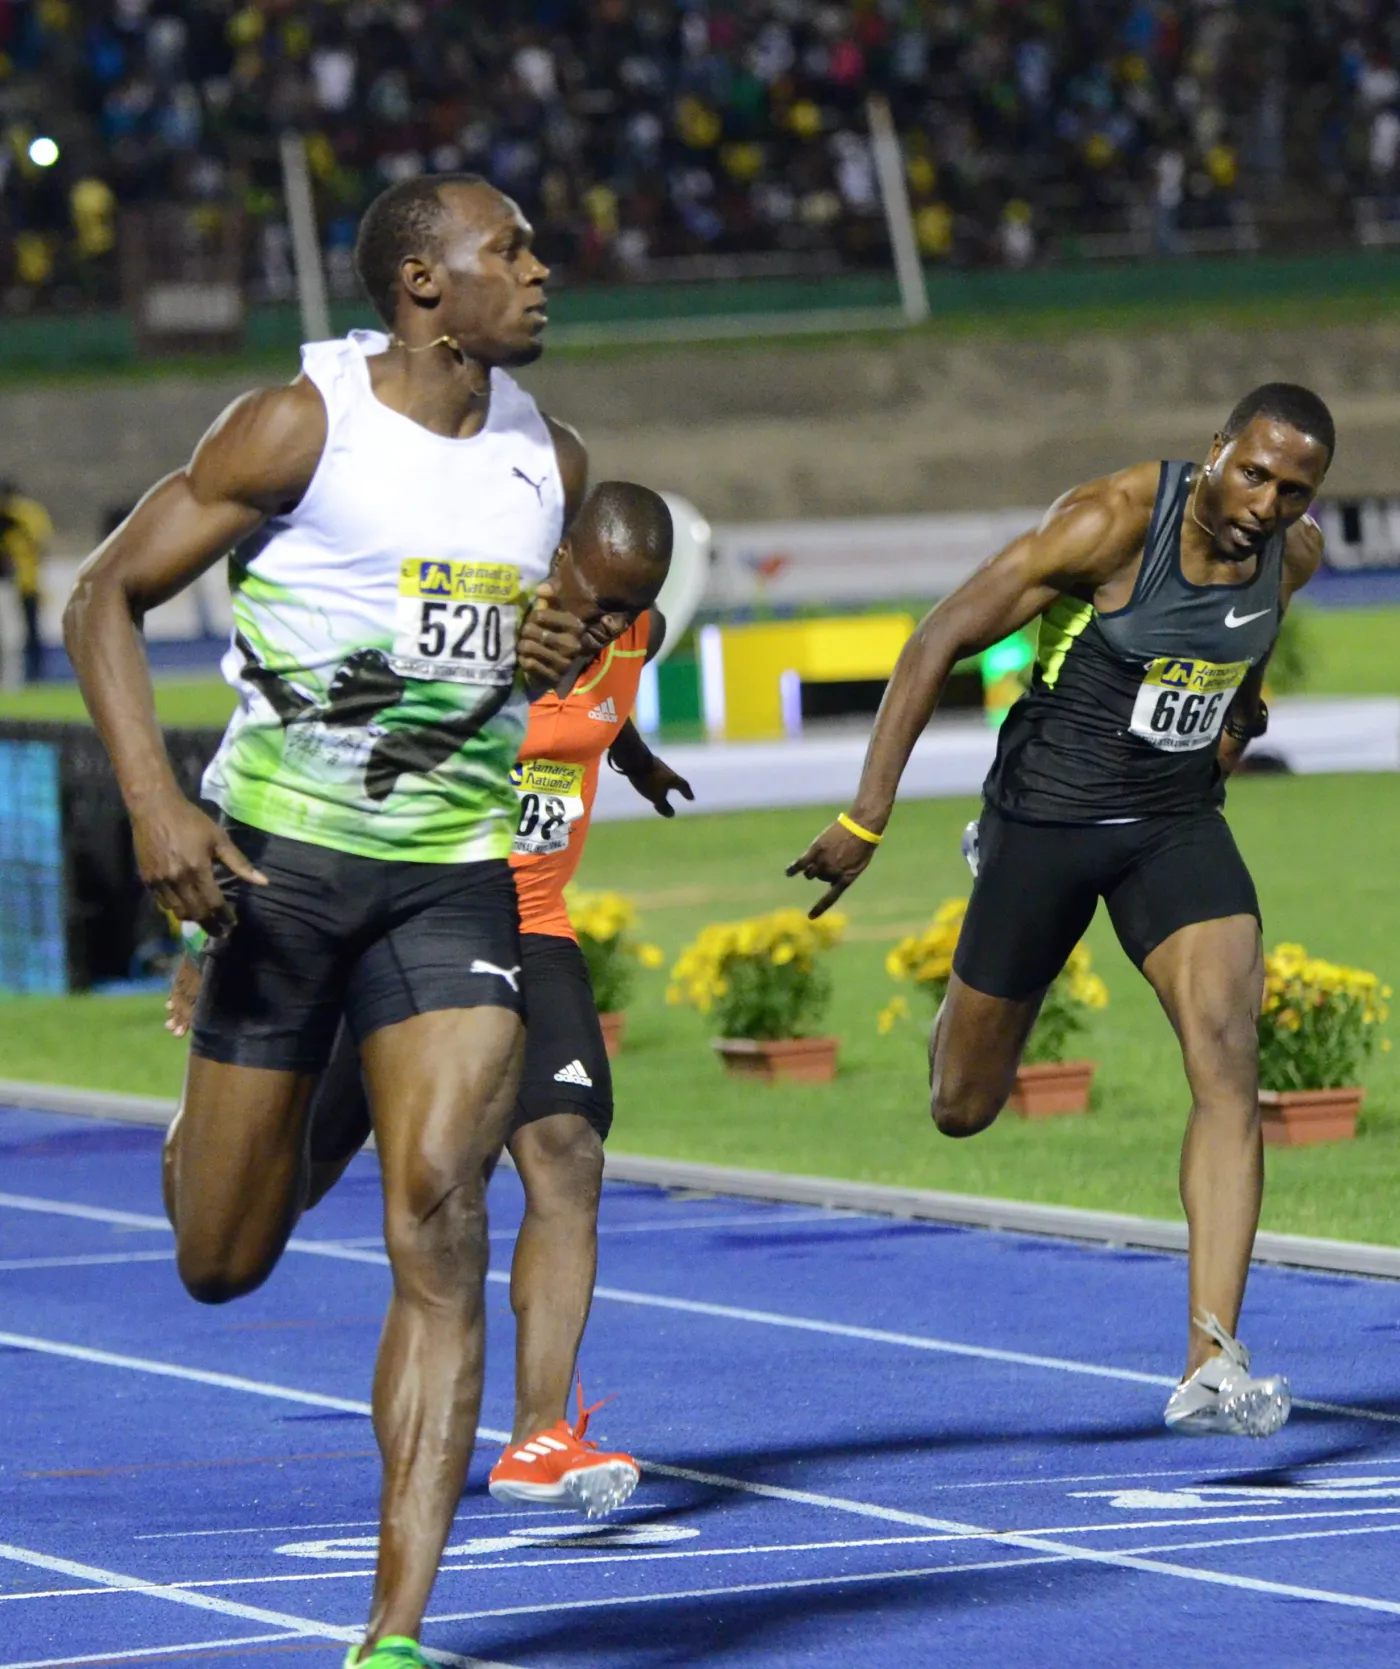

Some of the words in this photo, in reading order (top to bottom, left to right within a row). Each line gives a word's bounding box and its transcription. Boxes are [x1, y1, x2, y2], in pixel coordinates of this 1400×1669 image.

[455, 579, 513, 596] National
[418, 601, 501, 662] 520
[1150, 690, 1224, 735] 666
[526, 760, 577, 776] Jamaica
[525, 773, 576, 790] National
